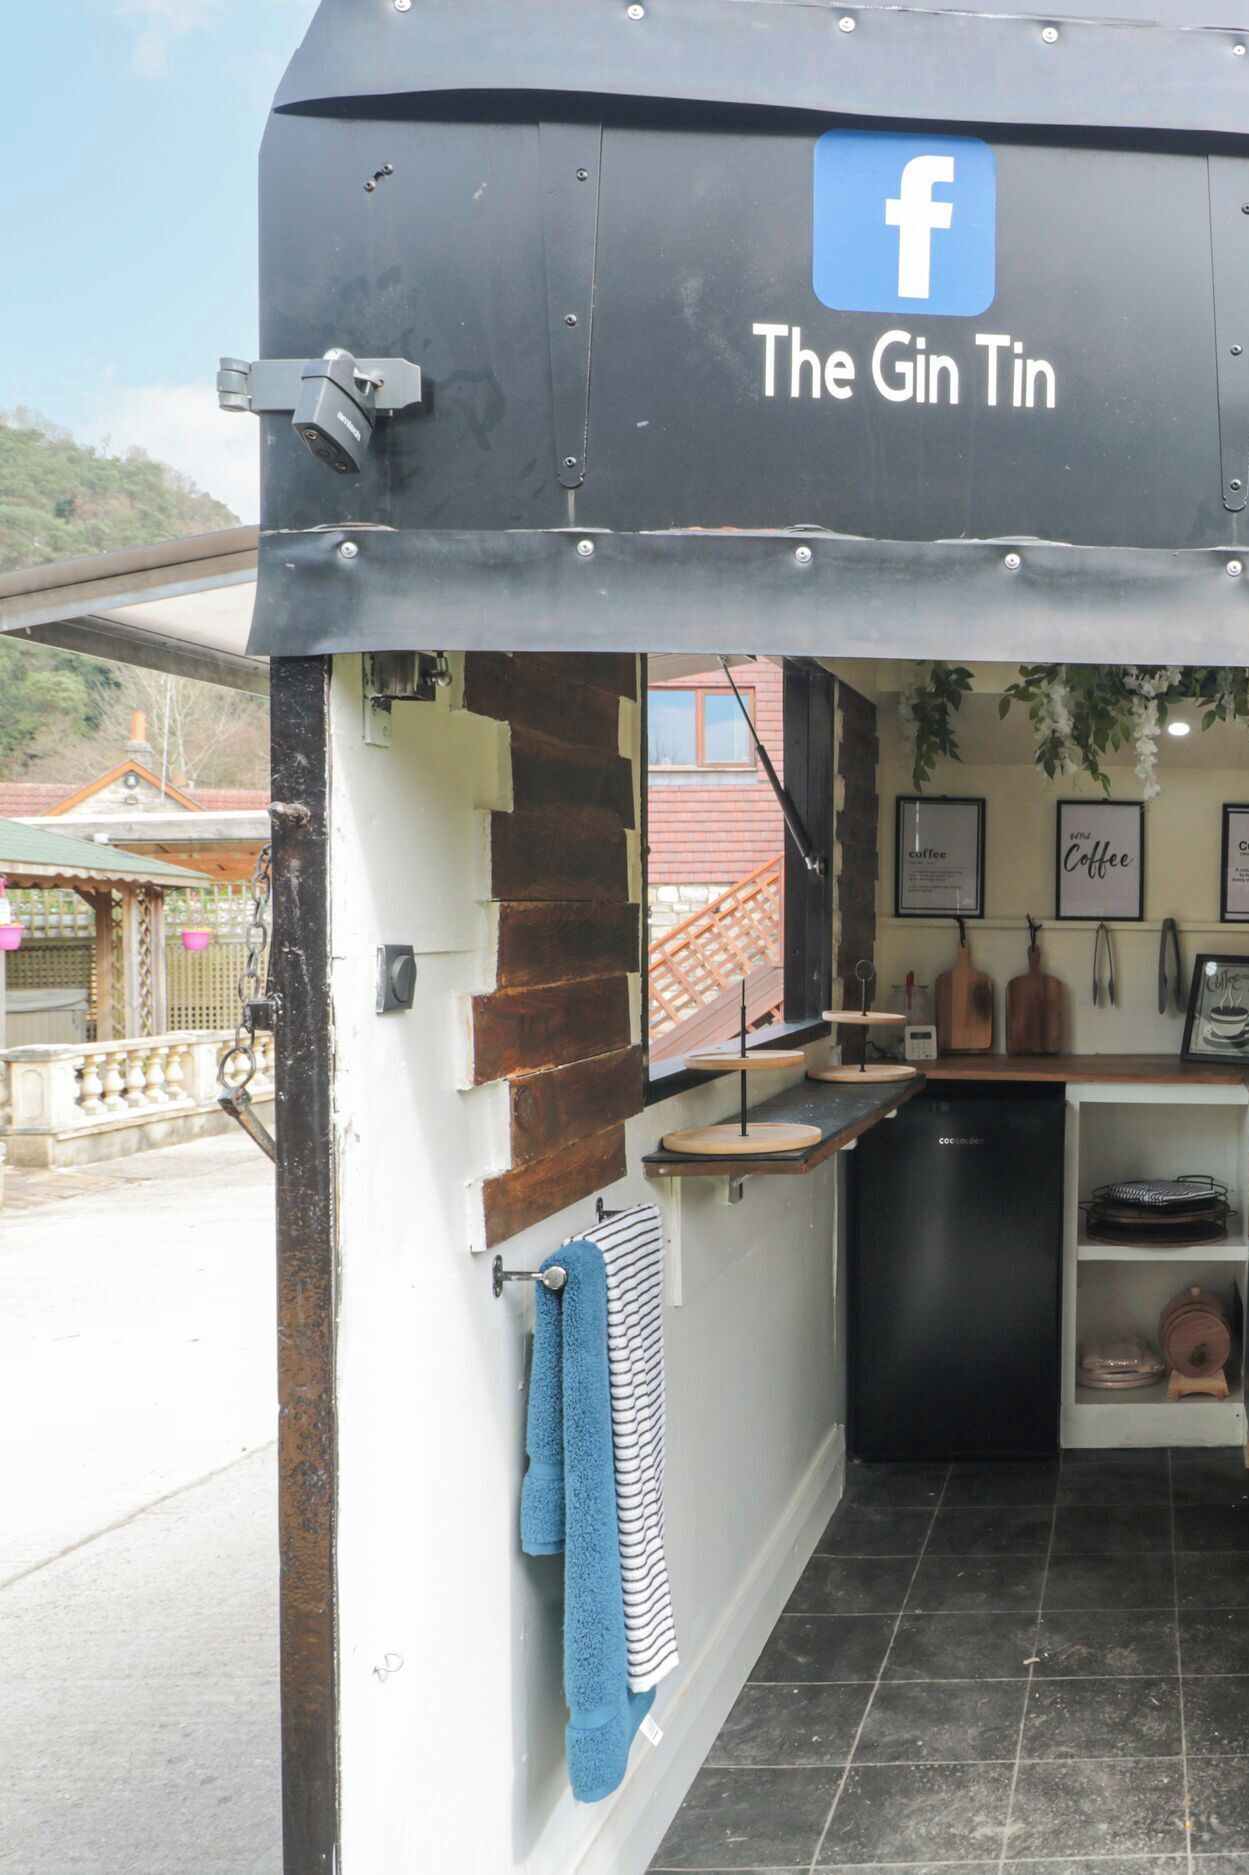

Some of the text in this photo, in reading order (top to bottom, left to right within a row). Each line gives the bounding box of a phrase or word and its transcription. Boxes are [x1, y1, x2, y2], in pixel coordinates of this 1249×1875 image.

[885, 155, 954, 299] f
[753, 323, 1055, 408] The Gin Tin
[908, 849, 946, 858] coffee
[1064, 841, 1134, 879] Coffee
[1206, 968, 1243, 993] Coffee
